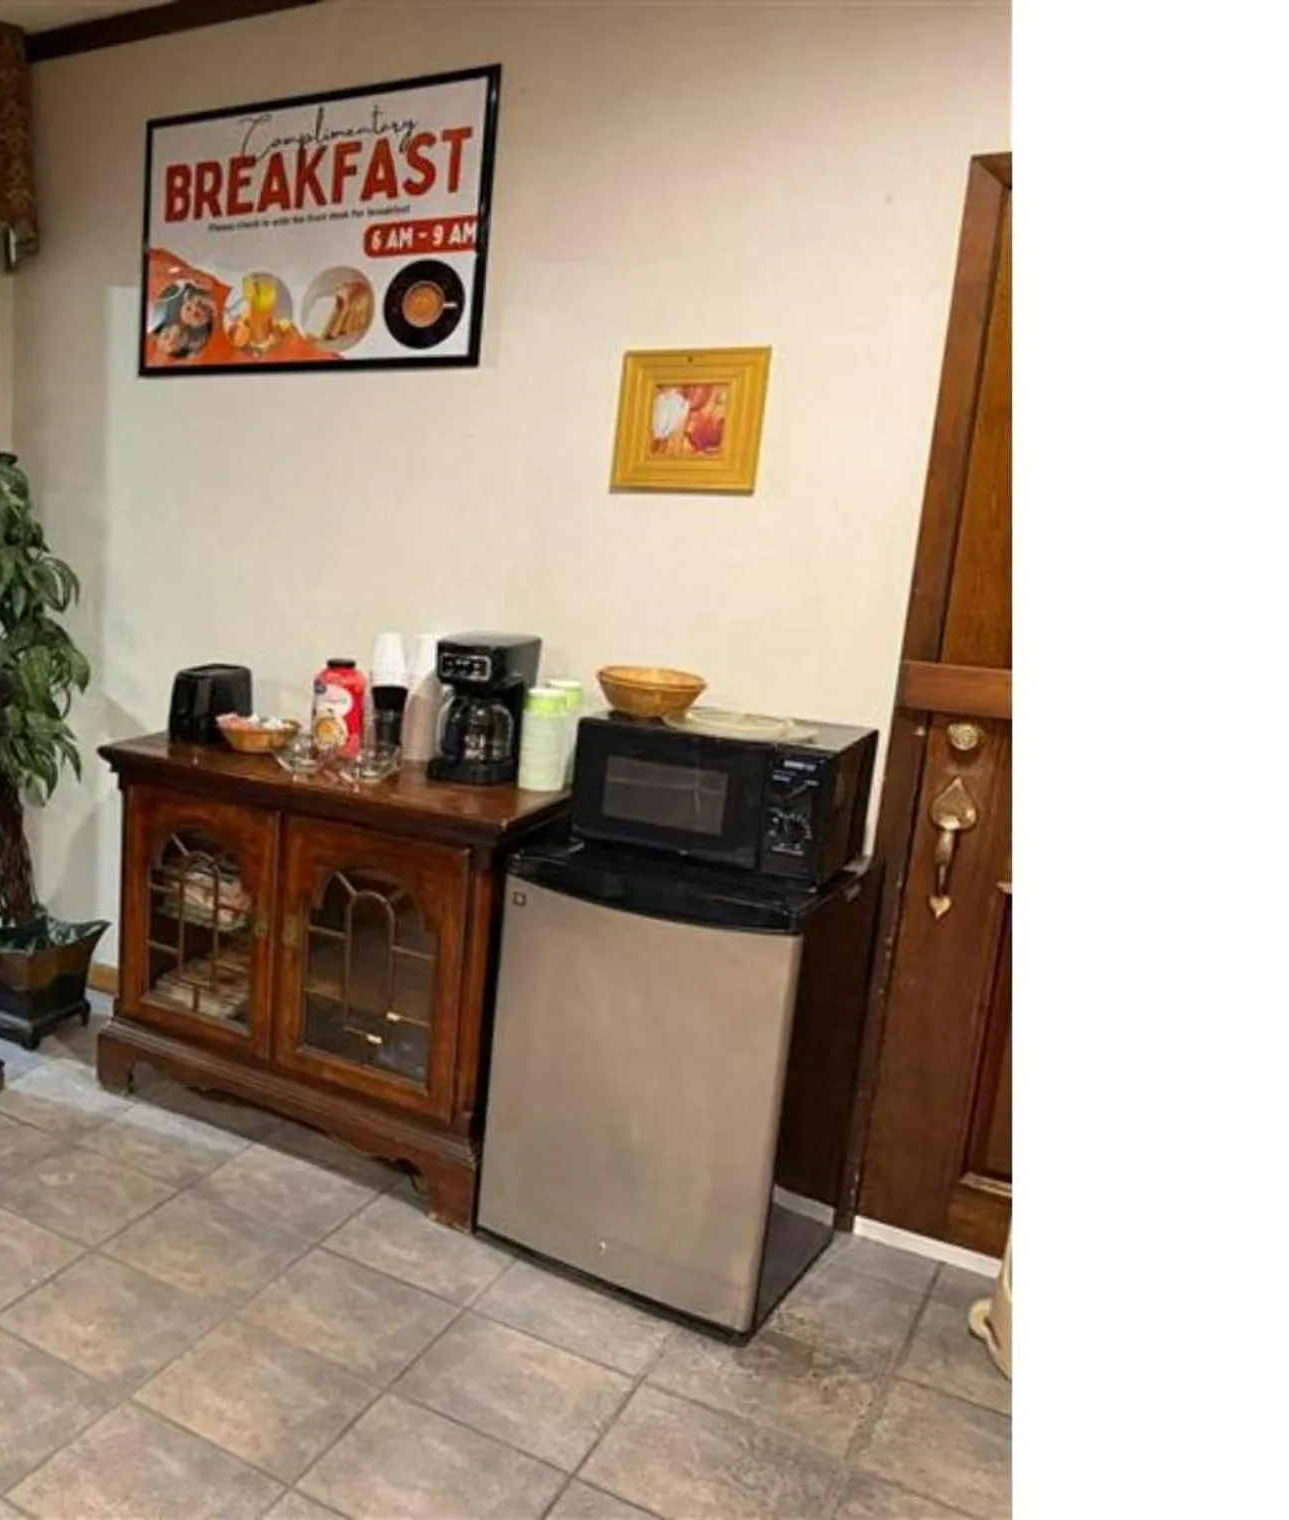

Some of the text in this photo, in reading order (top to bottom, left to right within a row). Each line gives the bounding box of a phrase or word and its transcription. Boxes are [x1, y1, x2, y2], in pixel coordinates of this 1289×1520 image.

[238, 104, 420, 158] Complimentary
[164, 126, 473, 222] BREAKFAST
[372, 229, 382, 251] 6
[386, 226, 414, 250] AM
[432, 223, 444, 247] 9
[448, 220, 477, 245] AM
